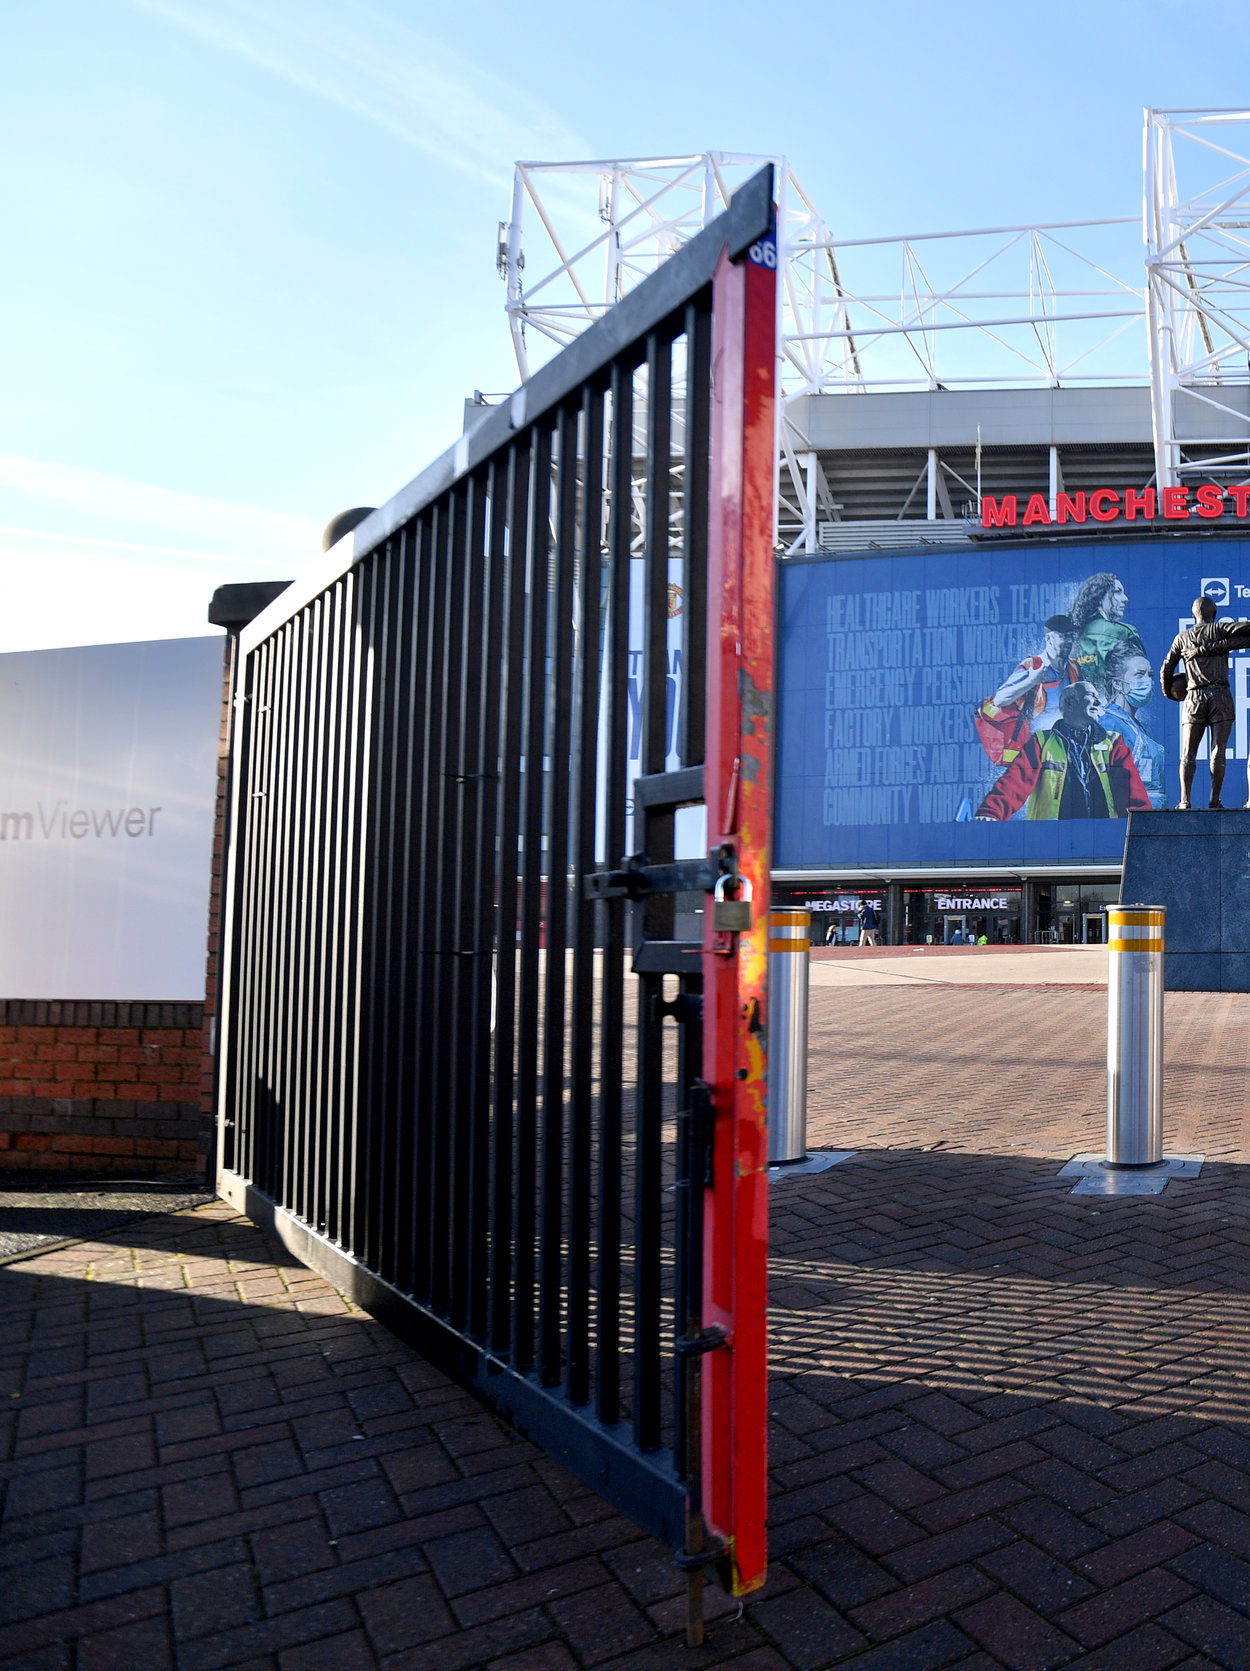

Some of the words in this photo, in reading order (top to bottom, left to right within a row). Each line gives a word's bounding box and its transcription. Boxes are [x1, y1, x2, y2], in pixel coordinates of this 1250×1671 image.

[826, 590, 921, 633] HEALTHCARE
[925, 586, 1000, 627] WORKERS
[827, 627, 957, 671] TRANSPORTATION
[825, 667, 917, 710] EMERGENCY
[825, 708, 894, 749] FACTORY
[900, 704, 975, 745] WORKERS
[825, 748, 872, 787] ARMED
[875, 745, 927, 785] FORCES
[931, 743, 960, 783] AND
[822, 785, 913, 826] COMMUNITY
[937, 897, 1008, 910] ENTRANCE
